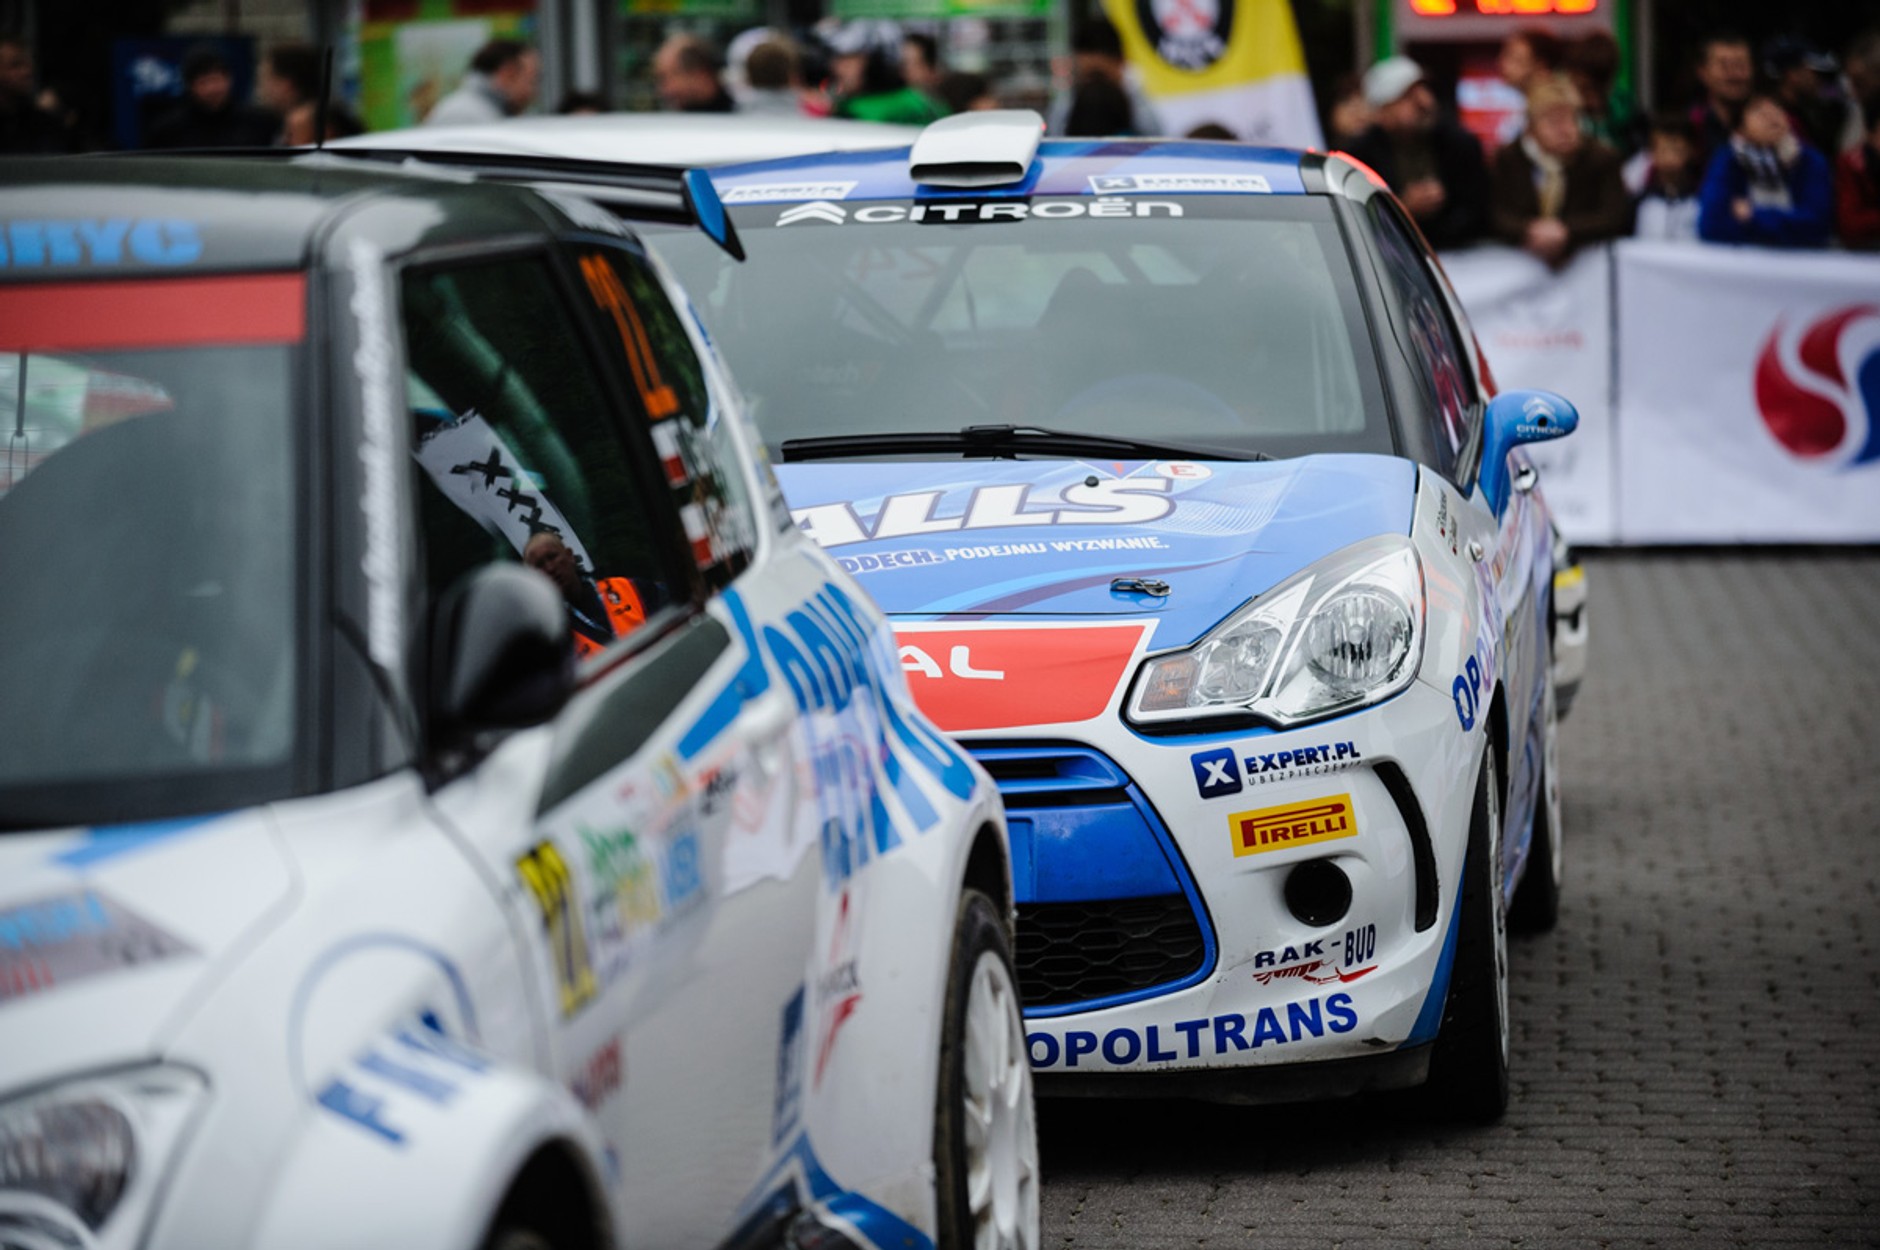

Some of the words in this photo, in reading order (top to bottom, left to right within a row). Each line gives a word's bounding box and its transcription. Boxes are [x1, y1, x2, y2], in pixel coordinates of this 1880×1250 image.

[853, 196, 1184, 223] CITROËN
[788, 475, 1178, 549] ALLS
[1050, 536, 1170, 551] WYZWANIE.
[1244, 741, 1360, 775] EXPERT.PL
[1240, 803, 1347, 848] PIRELLI
[1025, 992, 1358, 1068] OPOLTRANS
